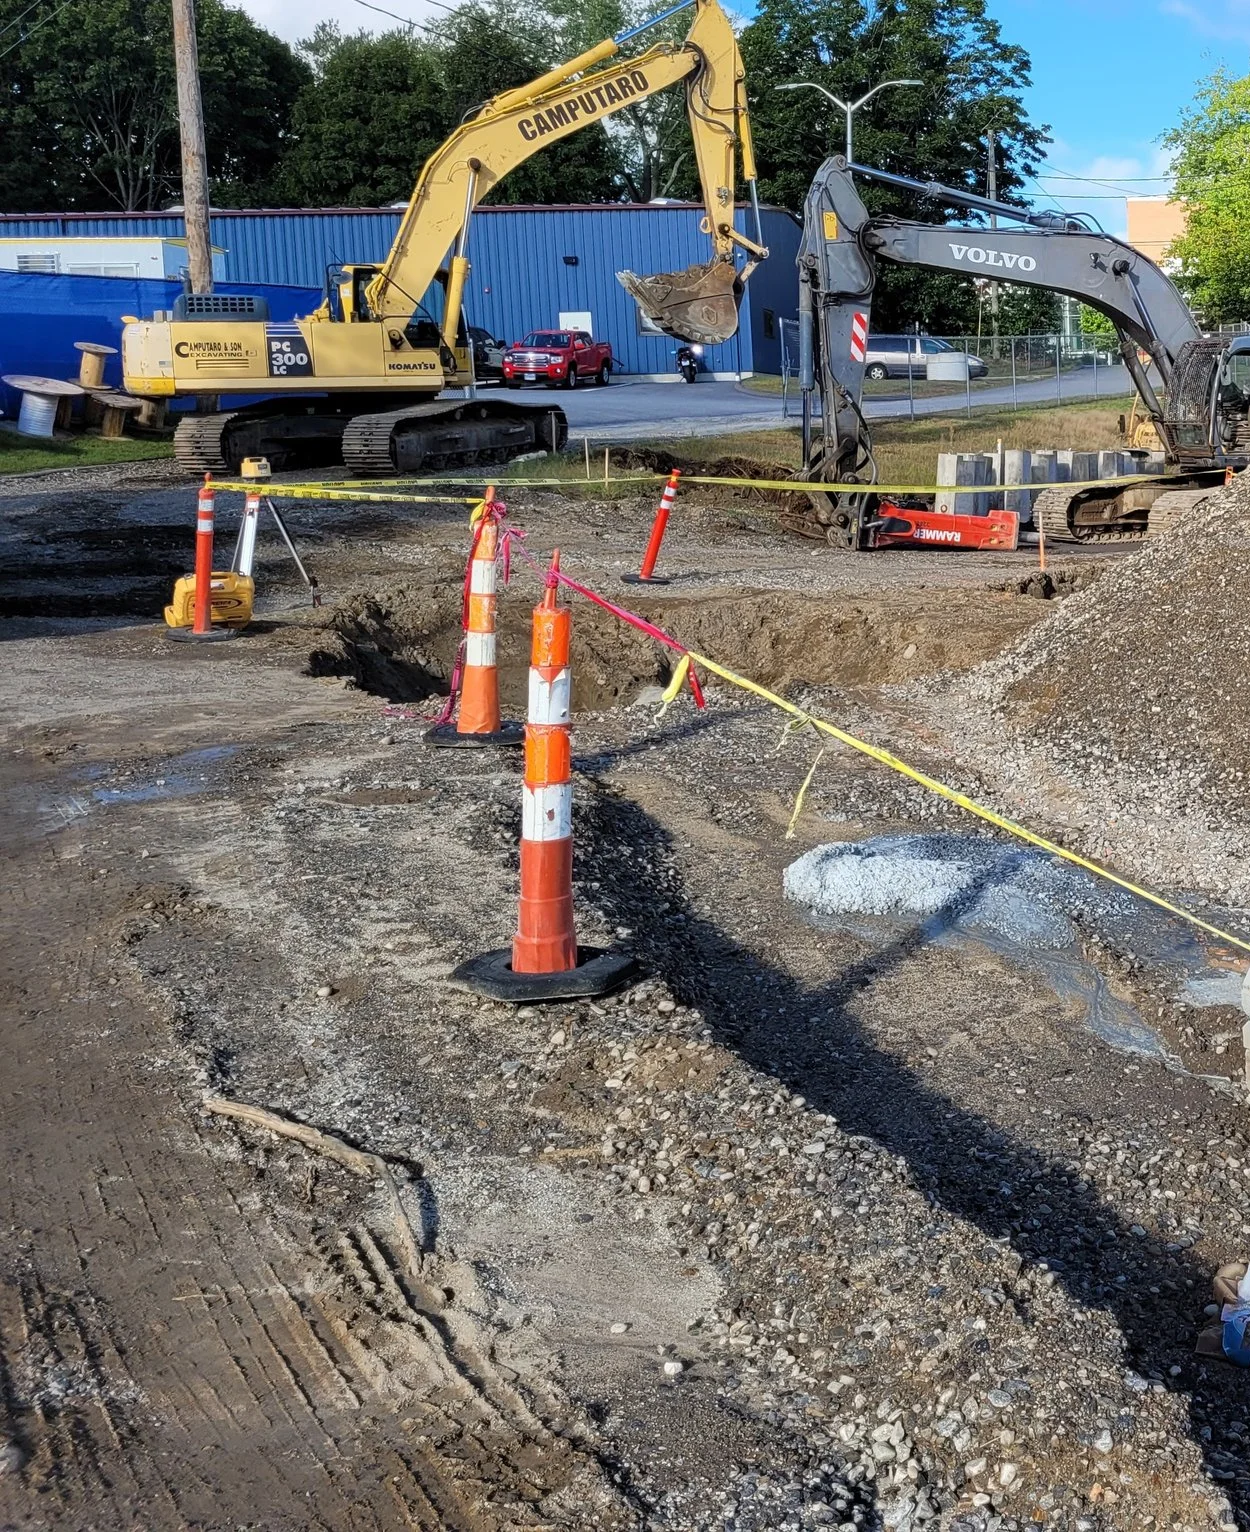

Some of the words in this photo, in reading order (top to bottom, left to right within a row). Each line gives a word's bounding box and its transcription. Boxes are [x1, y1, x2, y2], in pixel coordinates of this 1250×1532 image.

[517, 70, 649, 141] CAMPUTARO
[948, 243, 1037, 271] VOLVO
[175, 341, 221, 358] CAMPUTARO
[224, 342, 230, 351] &
[230, 342, 242, 351] SON
[271, 341, 291, 352] PC
[271, 353, 308, 365] 300
[273, 366, 287, 375] LC
[388, 362, 436, 370] KOMATSU
[912, 528, 962, 543] RAMMER
